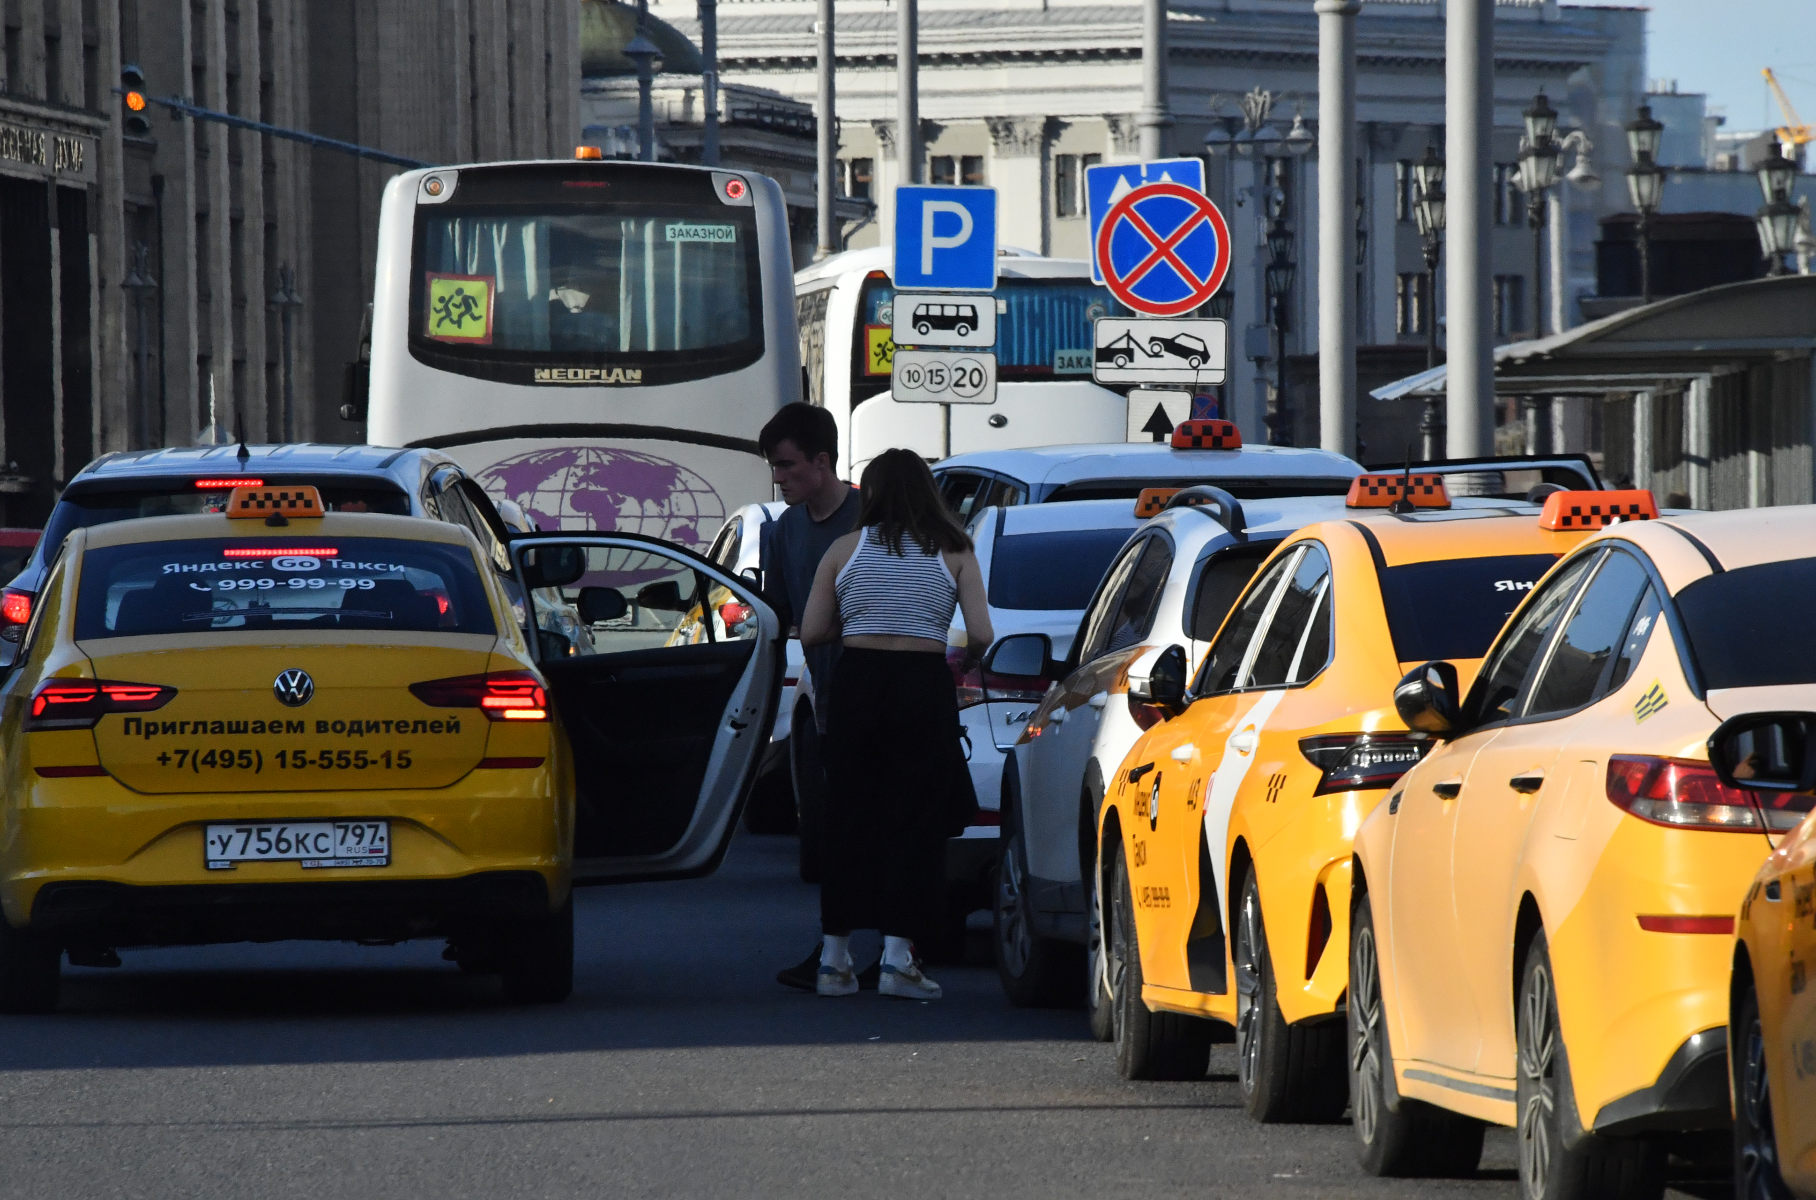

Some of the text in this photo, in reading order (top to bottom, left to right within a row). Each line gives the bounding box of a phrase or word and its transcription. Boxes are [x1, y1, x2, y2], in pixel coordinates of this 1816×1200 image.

[669, 226, 733, 240] ЗАКАЗНОЙ
[921, 200, 974, 275] P
[534, 367, 642, 383] NEOPLAN
[906, 367, 983, 388] 10 15 20
[162, 557, 406, 574] Яндекс Go Такси
[217, 578, 376, 590] 999-99-99
[123, 715, 461, 739] Приглашаем водителей
[157, 749, 412, 773] +7(495) 15-555-15
[336, 824, 380, 846] 797
[346, 846, 368, 854] RUS
